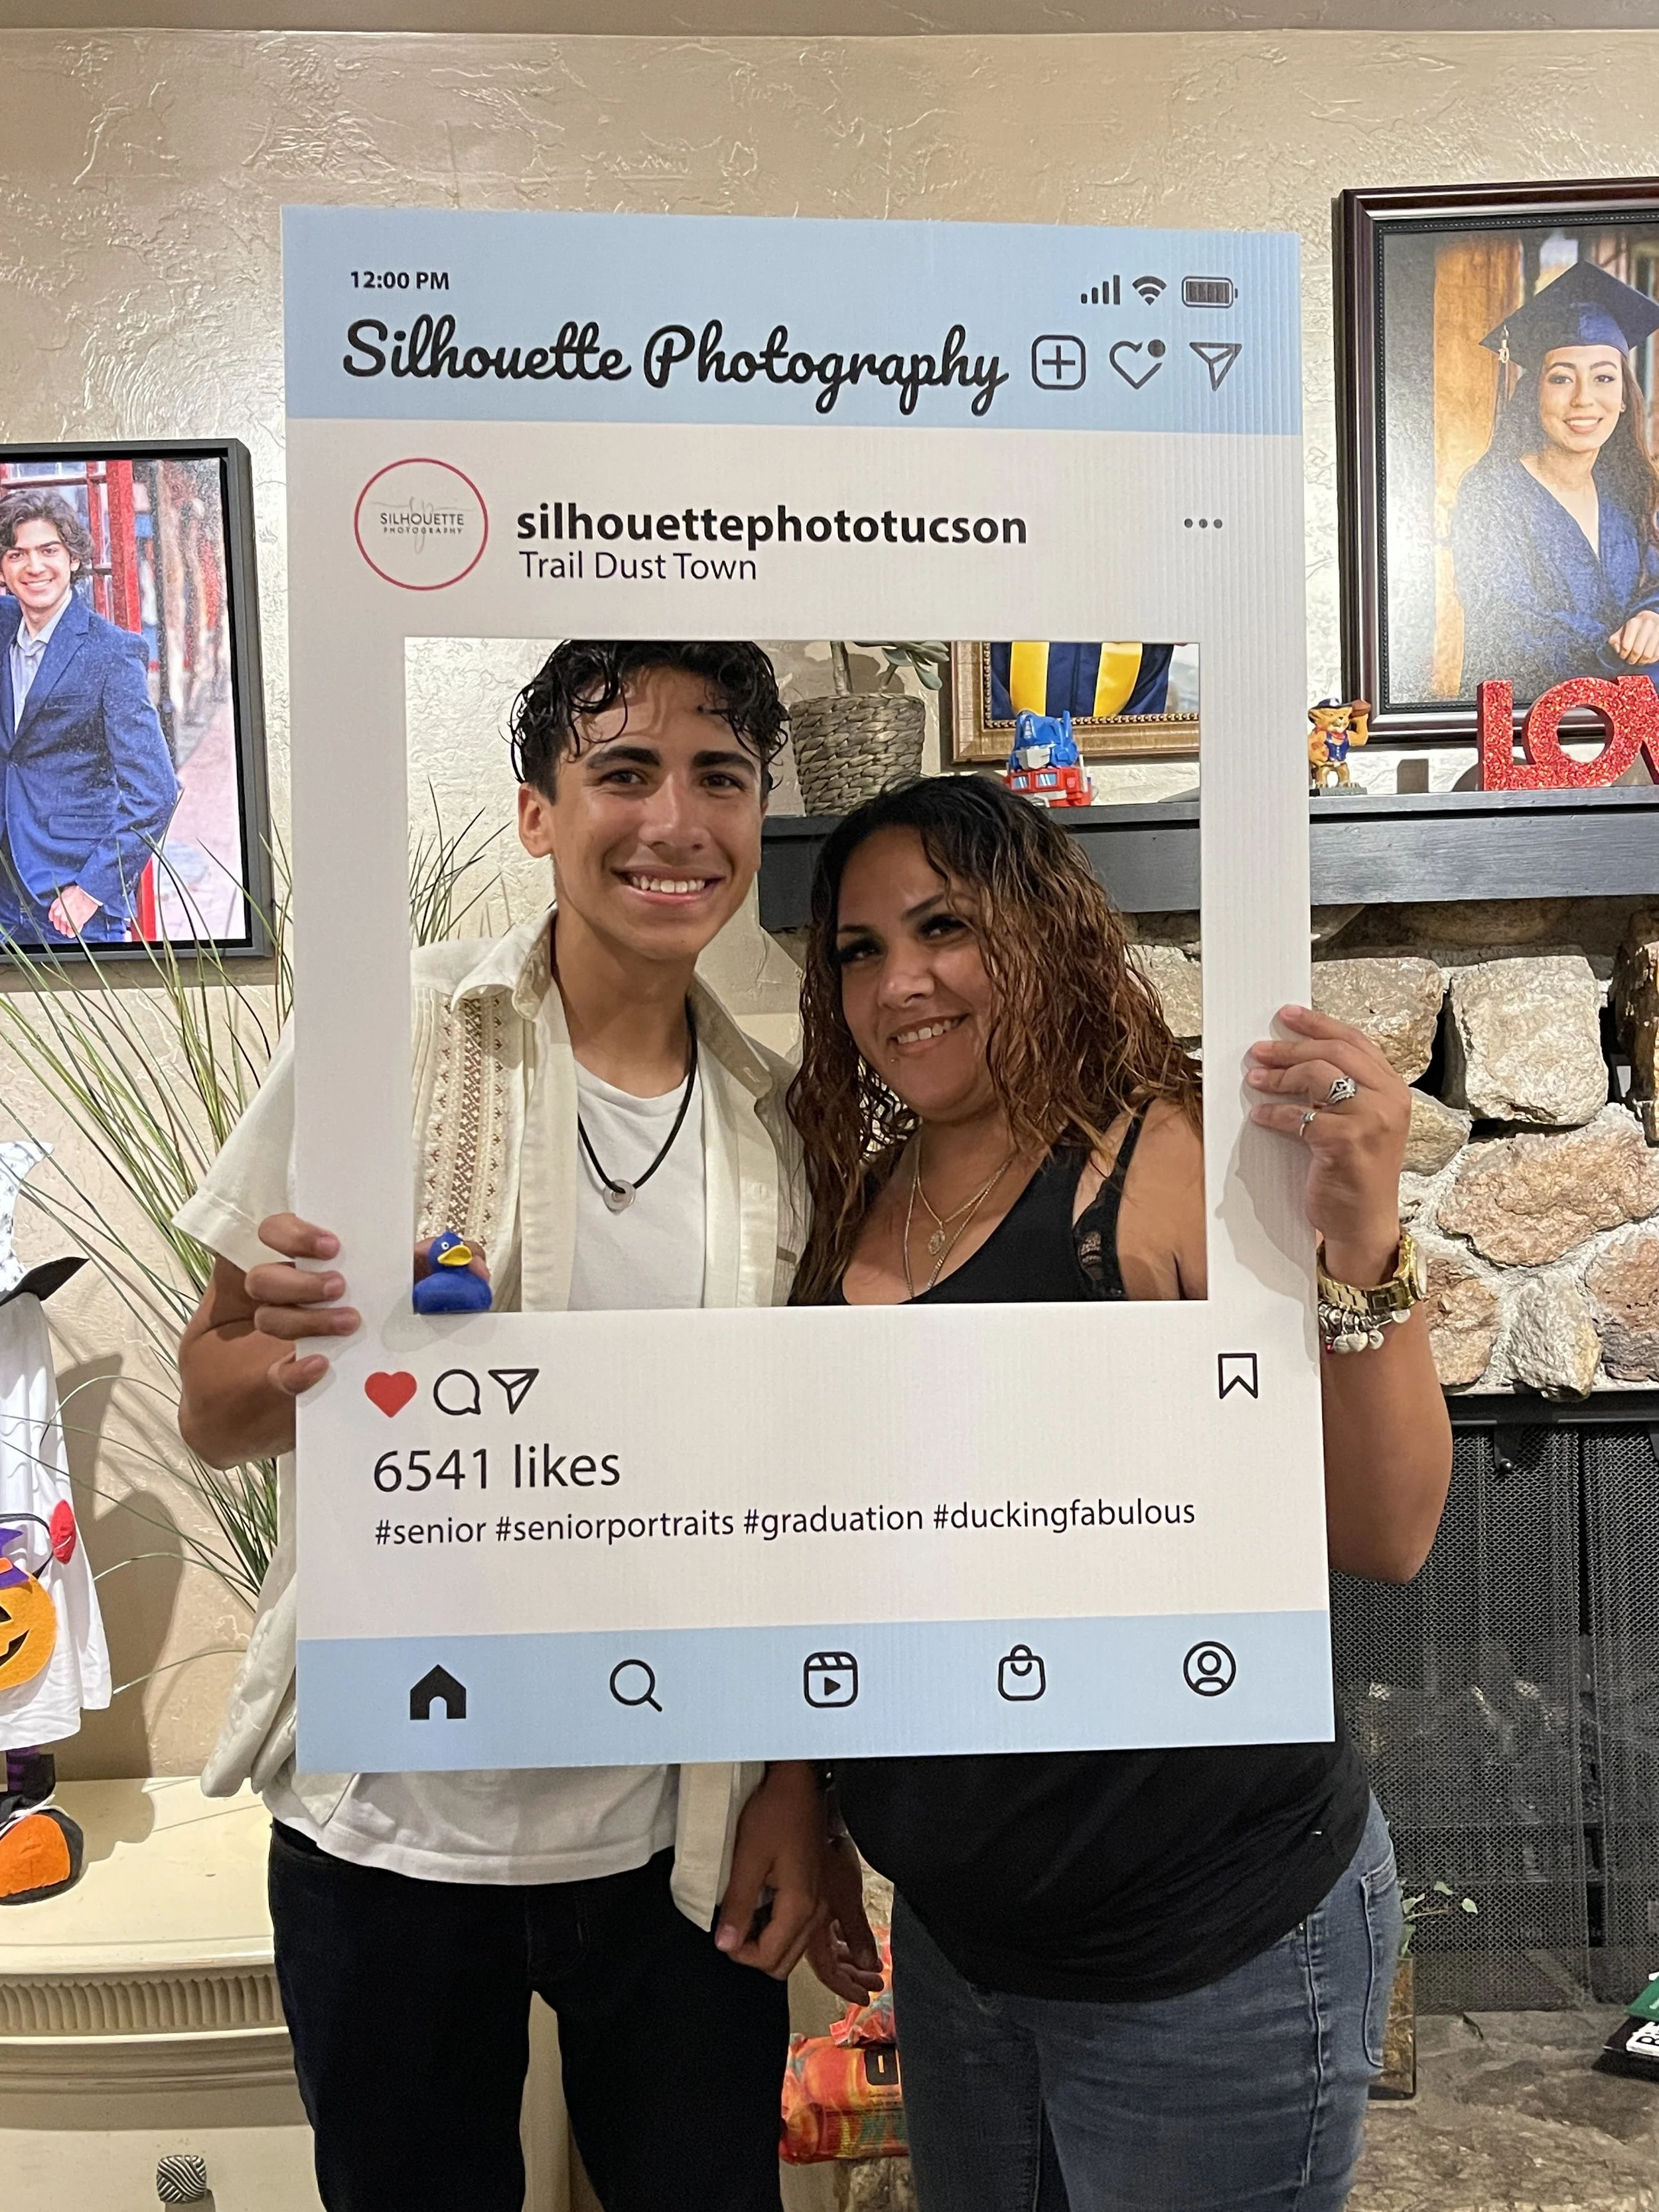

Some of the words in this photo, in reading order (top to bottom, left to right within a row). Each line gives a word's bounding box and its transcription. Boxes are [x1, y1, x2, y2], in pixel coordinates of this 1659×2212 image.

[350, 270, 410, 290] 12:00
[415, 271, 450, 291] PM
[342, 313, 632, 380] Silhouette
[642, 319, 1010, 417] Photography
[380, 512, 465, 526] SILHOUETTE
[383, 526, 463, 535] PHOTOGRAPHY
[516, 502, 1027, 550] silhouettephototucson
[518, 551, 584, 579] Trail
[595, 552, 667, 581] Dust
[672, 552, 757, 581] Town
[373, 1447, 490, 1493] 6541
[514, 1443, 621, 1489] likes
[374, 1516, 487, 1545] #senior
[495, 1509, 735, 1546] #seniorportraits
[743, 1504, 923, 1542] #graduation
[932, 1497, 1196, 1534] #duckingfabulous
